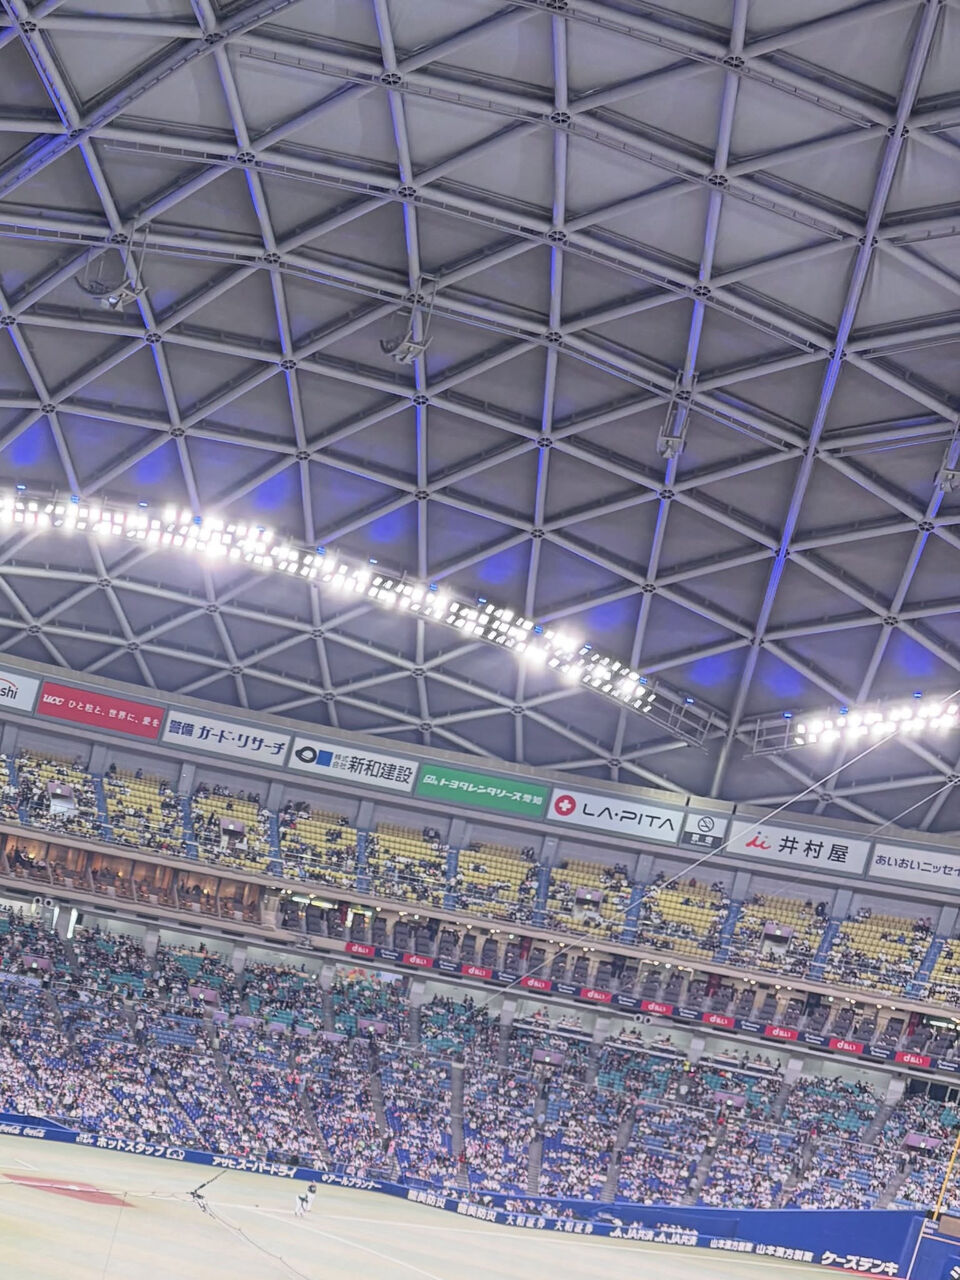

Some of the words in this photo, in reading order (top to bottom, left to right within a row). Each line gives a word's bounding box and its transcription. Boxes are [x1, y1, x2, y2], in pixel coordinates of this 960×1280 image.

[347, 756, 413, 784] 新和建設
[778, 835, 849, 863] 井村屋
[821, 1250, 899, 1276] ケーズデンキ
